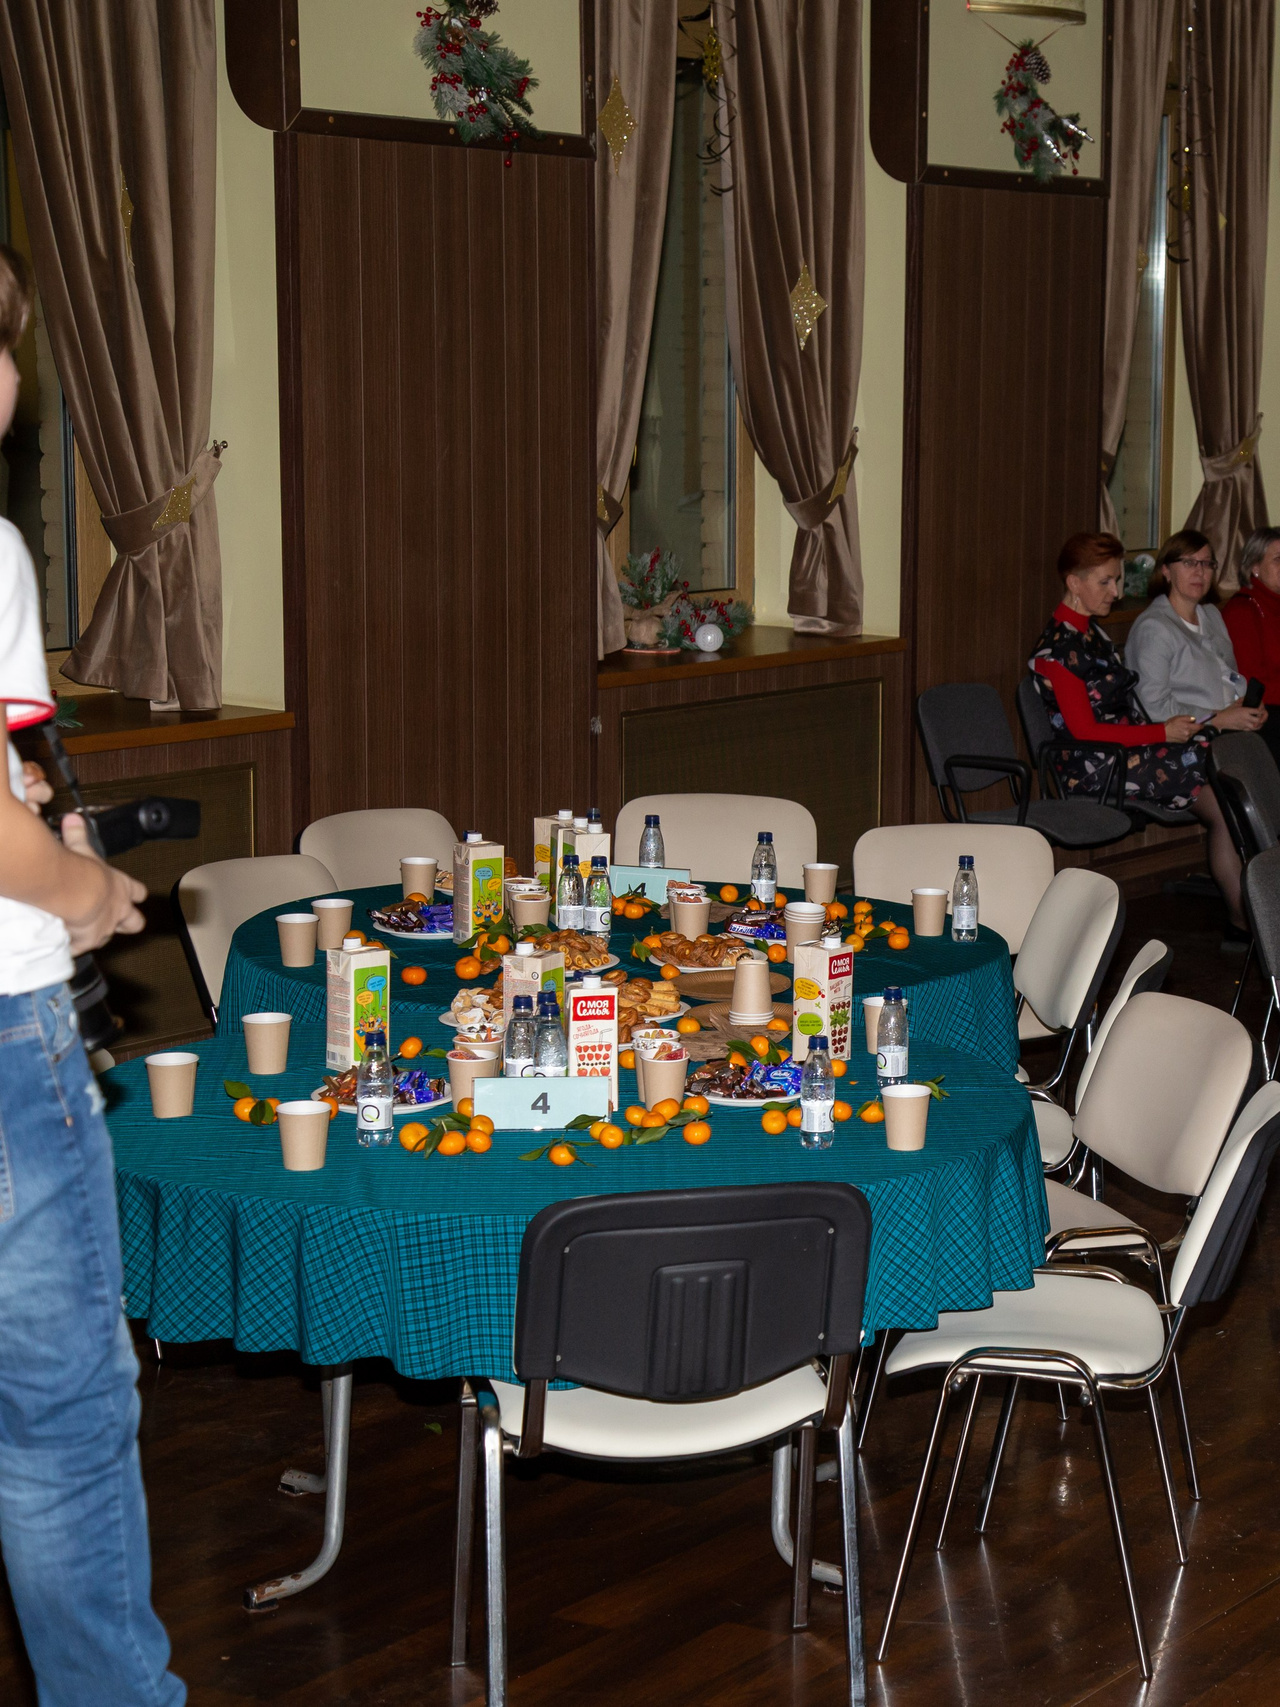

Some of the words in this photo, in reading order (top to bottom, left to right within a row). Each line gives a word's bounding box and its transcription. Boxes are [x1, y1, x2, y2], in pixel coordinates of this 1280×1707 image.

[633, 882, 647, 897] 4
[831, 959, 851, 975] Семья
[837, 956, 850, 966] МОЯ
[576, 999, 610, 1017] Семья
[587, 1000, 609, 1009] МОЯ
[530, 1092, 551, 1115] 4
